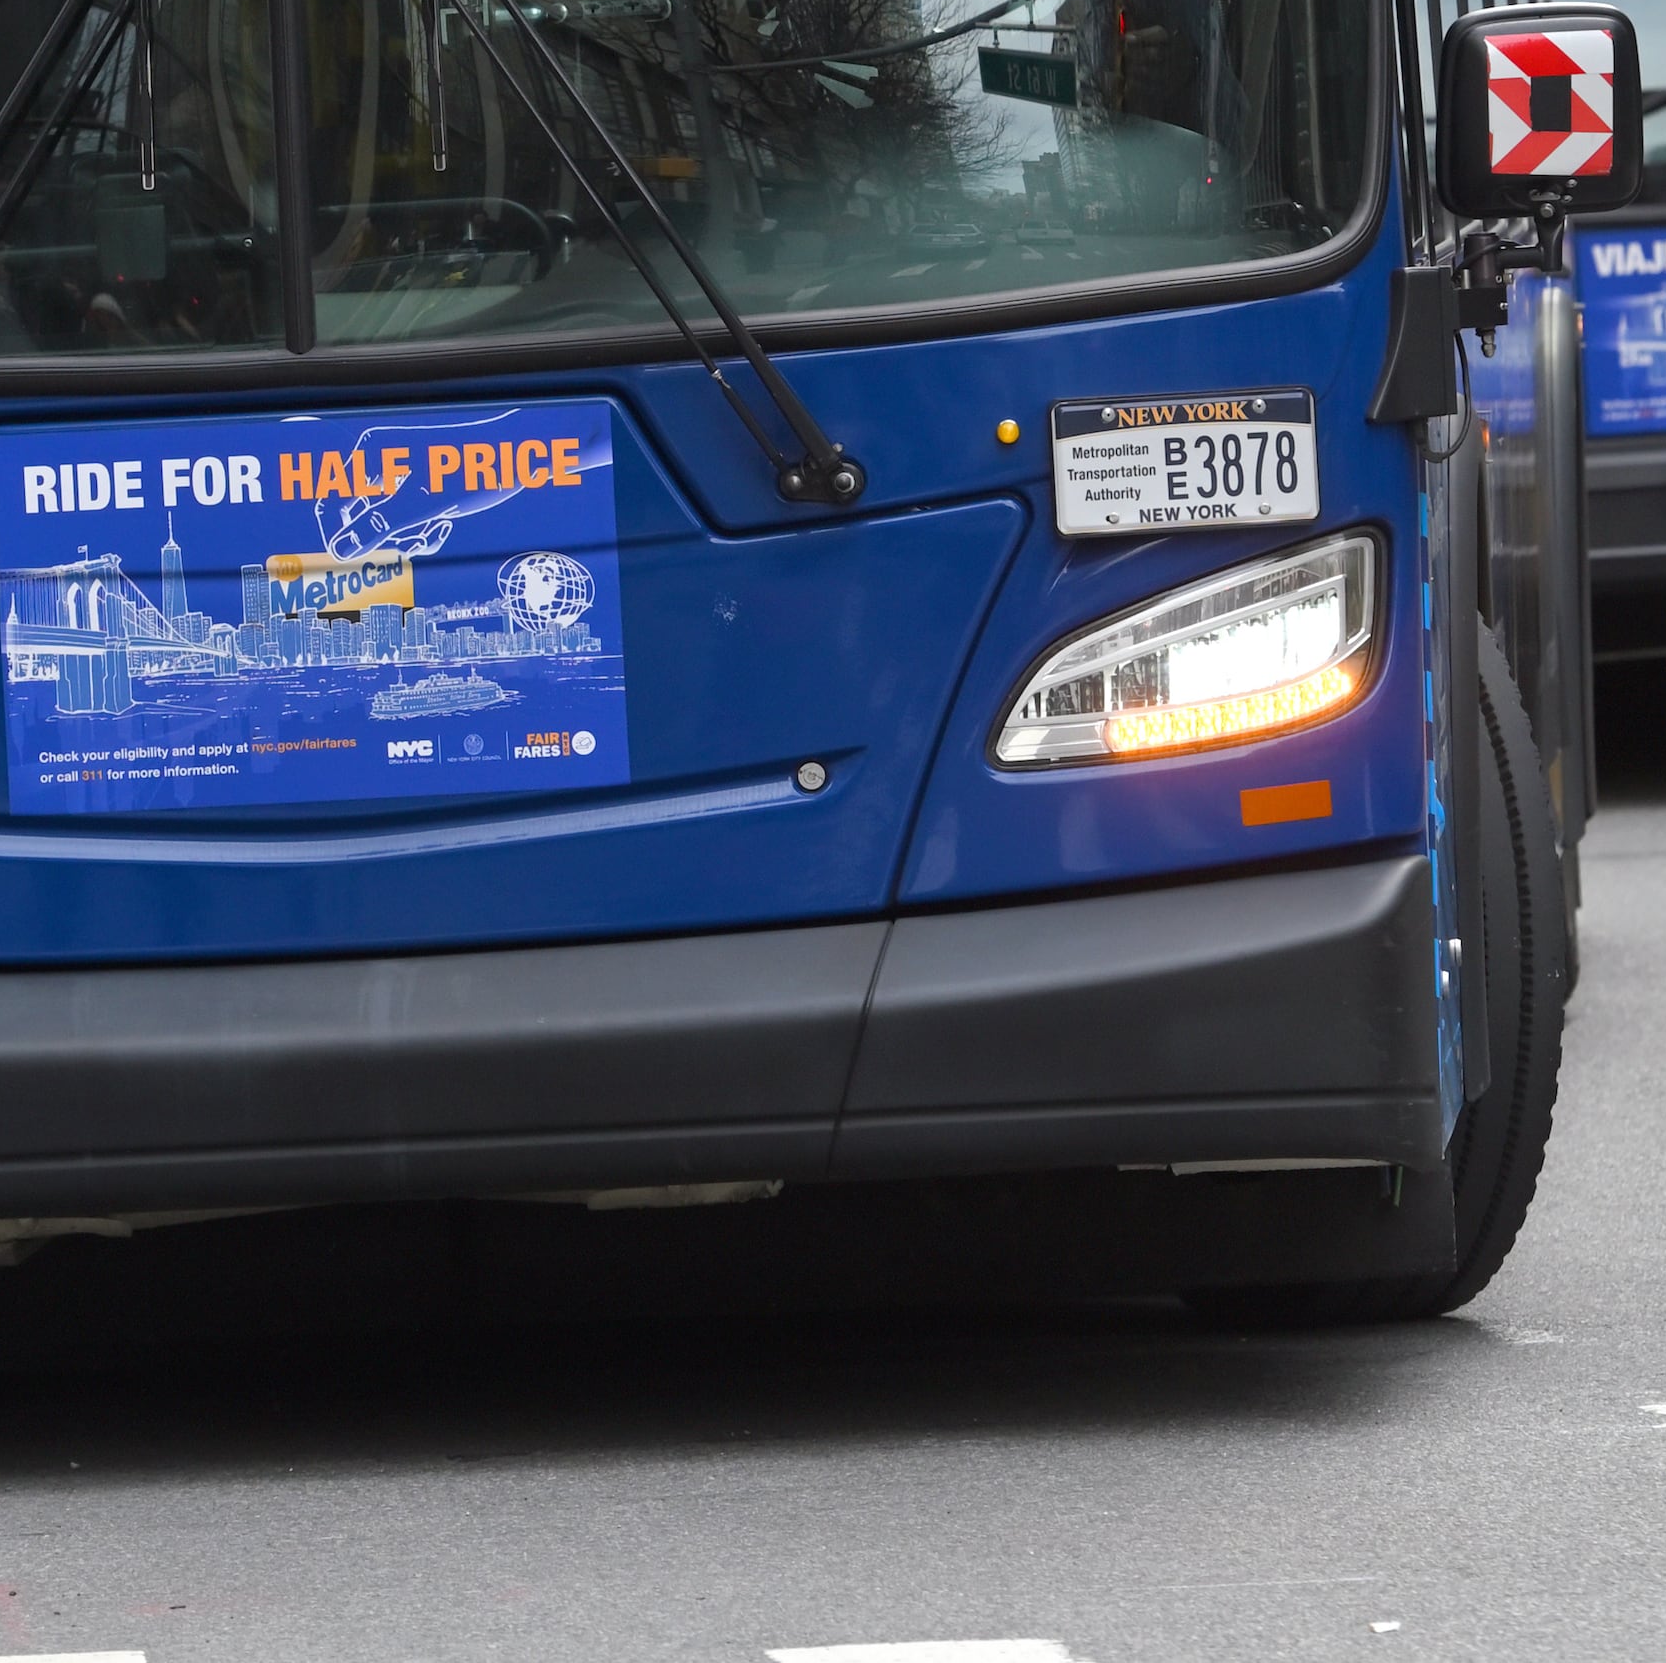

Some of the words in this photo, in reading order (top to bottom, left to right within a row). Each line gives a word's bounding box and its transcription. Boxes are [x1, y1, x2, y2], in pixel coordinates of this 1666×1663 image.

[1116, 405, 1178, 428] NEW
[1183, 400, 1250, 422] YORK
[1072, 443, 1150, 463] Metropolitan
[23, 459, 144, 513] RIDE
[161, 455, 264, 506] FOR
[278, 447, 410, 501] HALF
[428, 437, 582, 494] PRICE
[1067, 464, 1157, 483] Transportation
[1194, 430, 1298, 499] 3878
[1085, 486, 1142, 502] Authority
[1139, 507, 1181, 524] NEW
[1186, 503, 1237, 520] YORK
[269, 554, 404, 617] MetroCard
[387, 740, 433, 758] NYC
[526, 732, 560, 746] FAIR
[39, 750, 79, 764] Check
[82, 750, 110, 763] your
[113, 745, 169, 762] eligibility
[172, 744, 195, 757] and
[199, 743, 233, 758] apply
[236, 742, 249, 754] at
[251, 736, 357, 754] nyc.gov/fairfares
[514, 745, 561, 759] FARES
[40, 773, 53, 784] or
[57, 770, 78, 782] call
[82, 770, 103, 781] 311
[107, 768, 125, 780] for
[128, 767, 161, 779] more
[163, 763, 239, 778] information.
